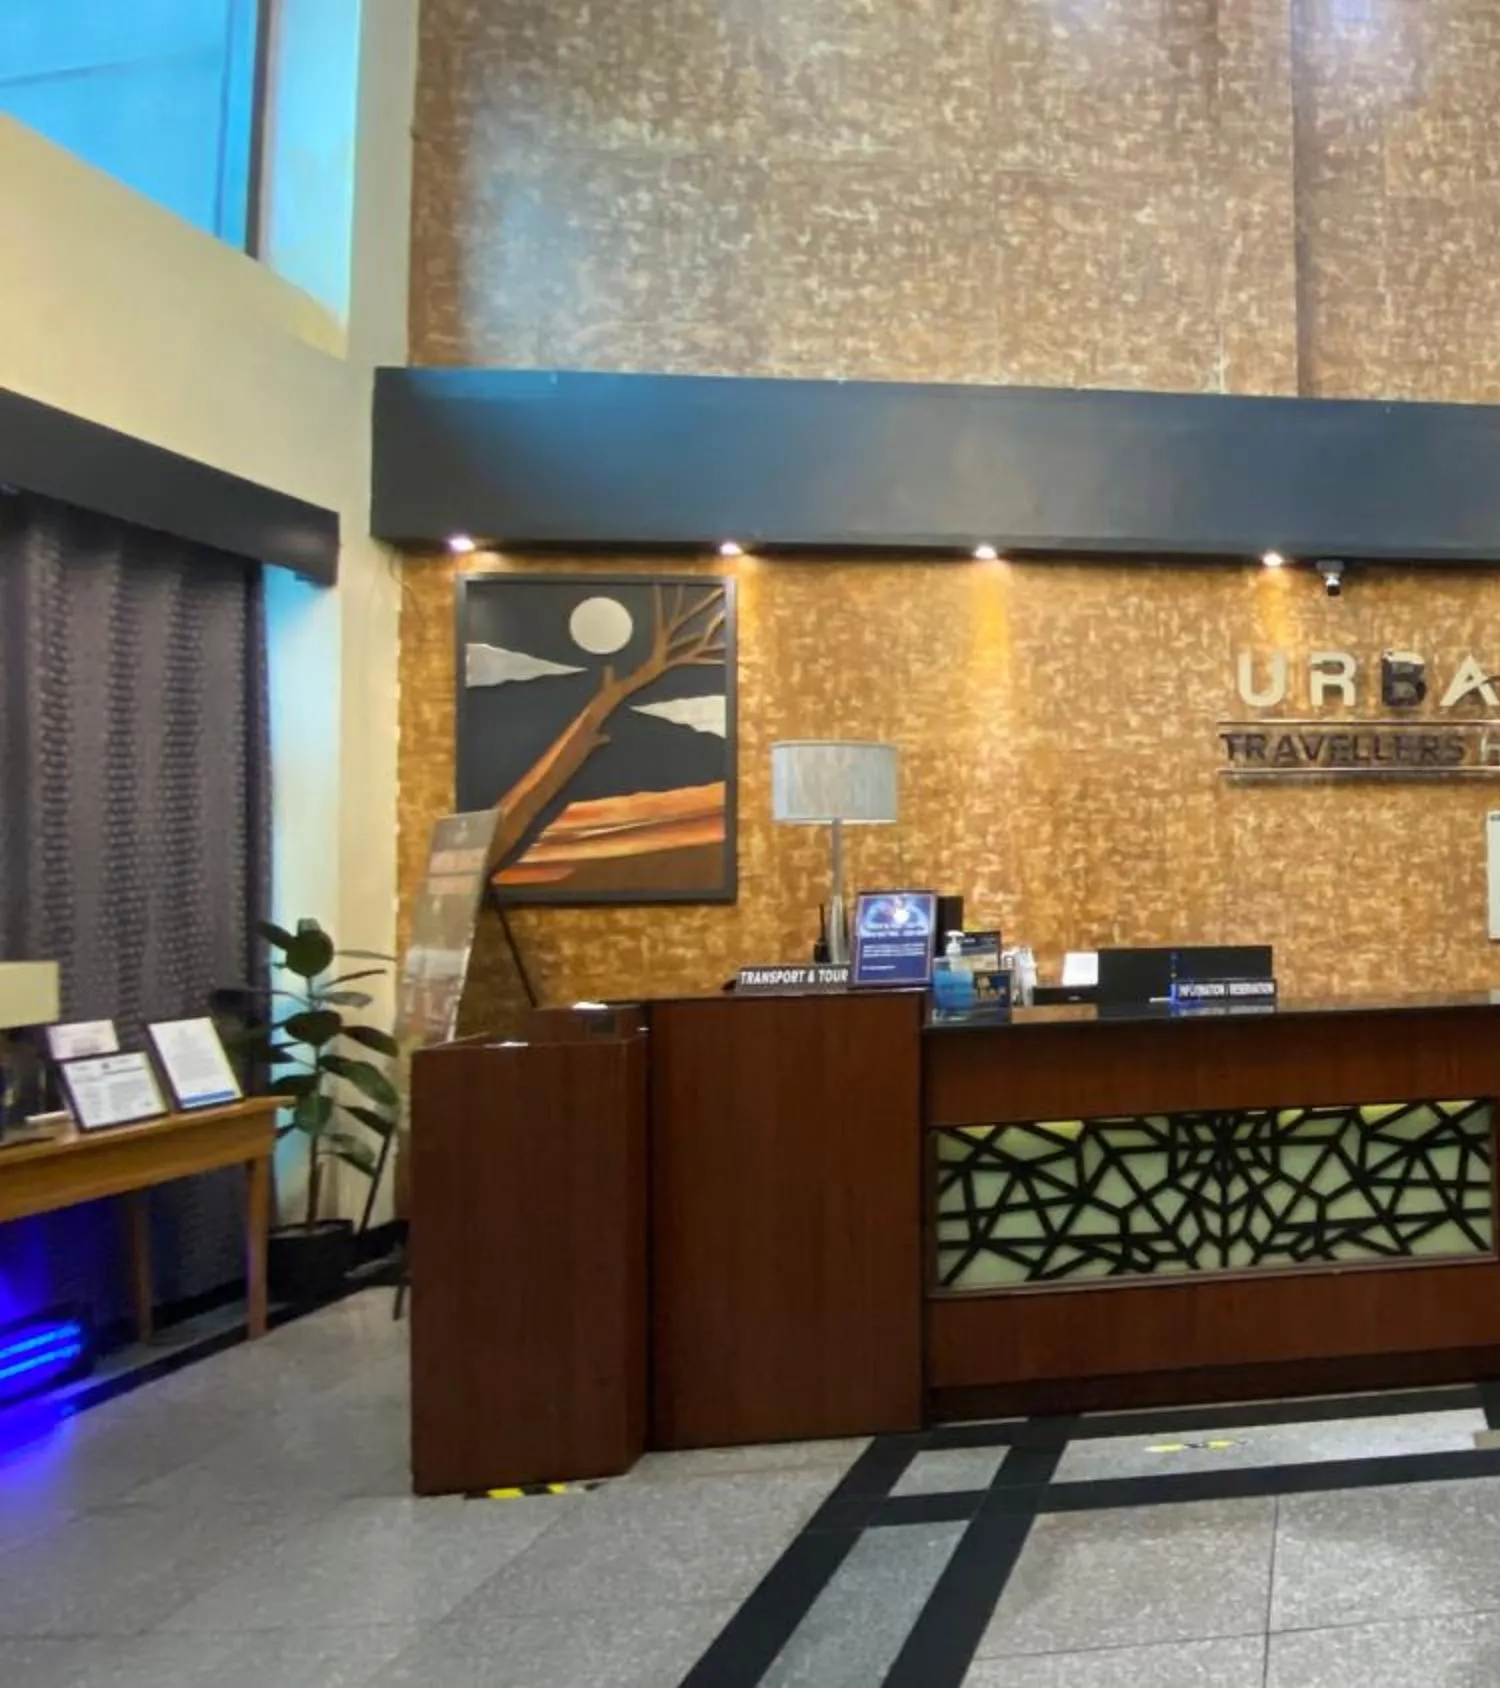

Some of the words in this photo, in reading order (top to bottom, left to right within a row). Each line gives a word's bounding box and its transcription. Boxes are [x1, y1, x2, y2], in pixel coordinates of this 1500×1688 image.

[1219, 732, 1466, 763] TRAVELLERS
[741, 969, 805, 985] TRANSPORT
[818, 968, 849, 983] TOUR
